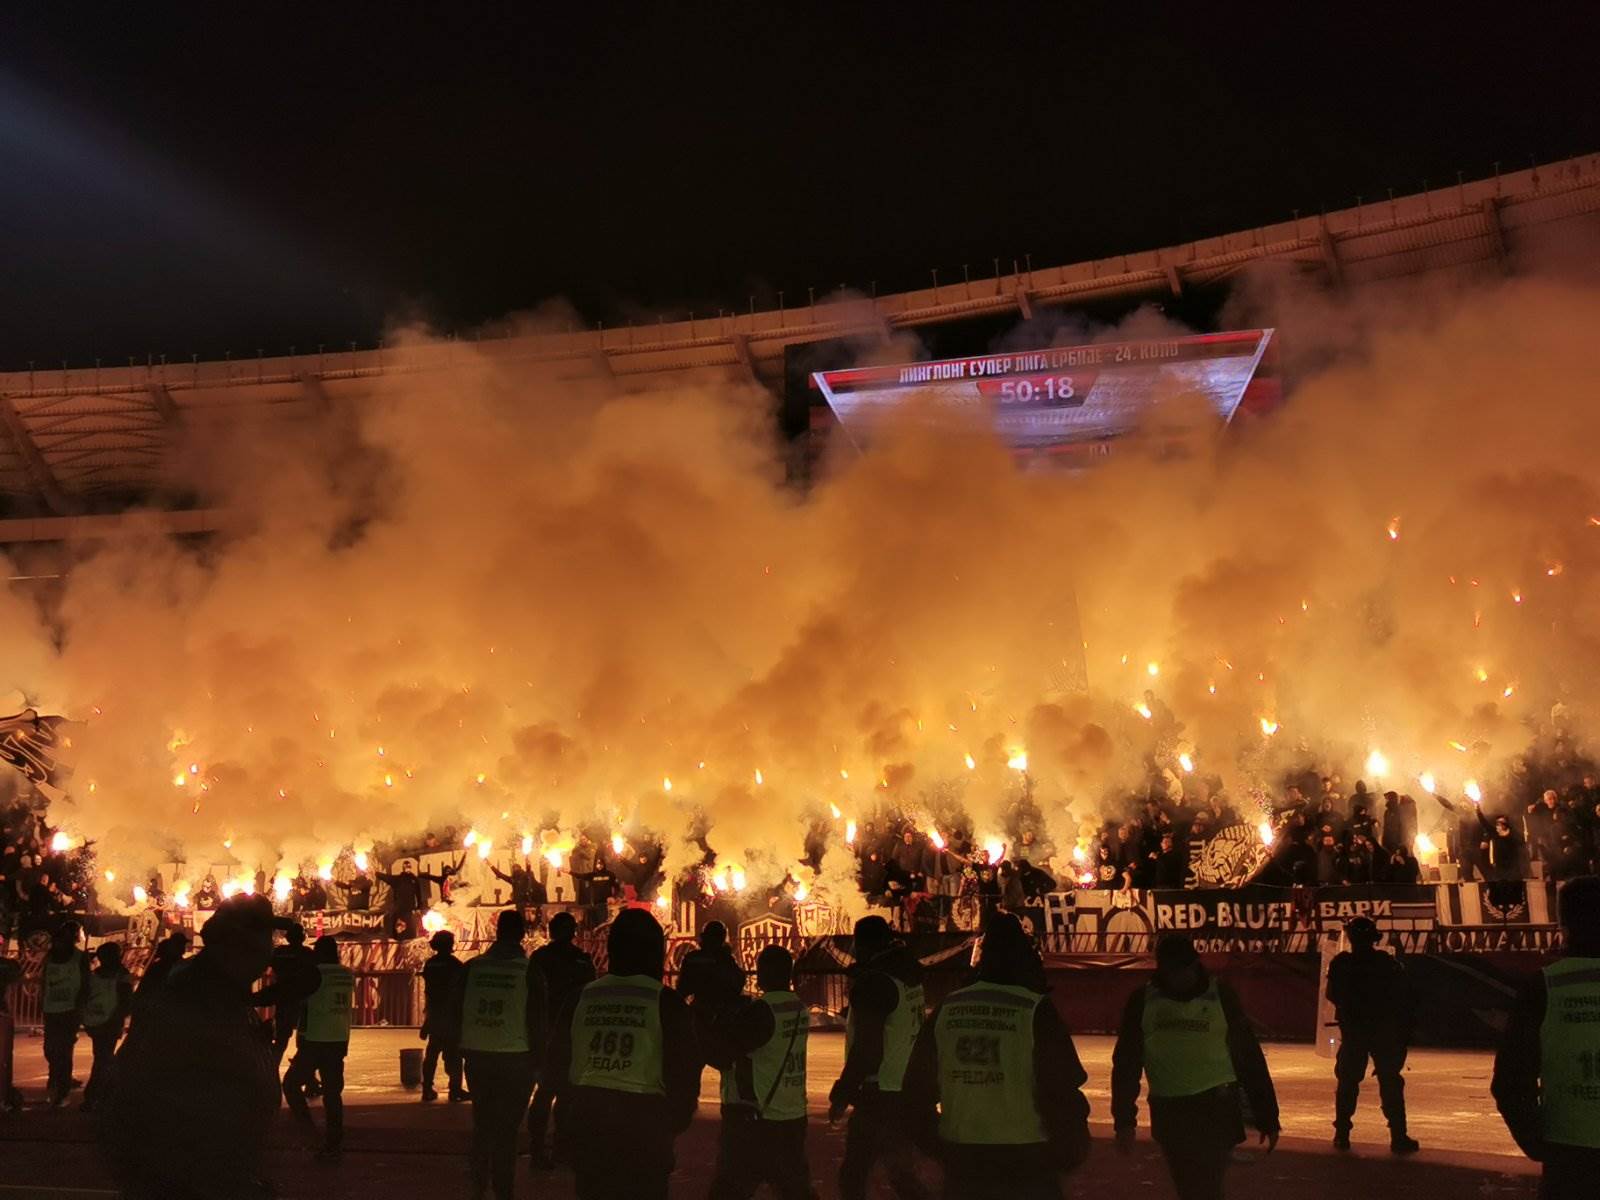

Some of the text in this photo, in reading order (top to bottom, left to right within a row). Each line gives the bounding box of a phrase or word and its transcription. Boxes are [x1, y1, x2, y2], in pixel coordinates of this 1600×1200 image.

[969, 357, 1012, 377] СУПЕР
[1015, 353, 1049, 372] ЛИГА
[1051, 348, 1103, 369] СРБИЈЕ
[1115, 345, 1138, 363] 24.
[1140, 341, 1179, 360] КОЛО
[1000, 376, 1075, 404] 50:18
[589, 1030, 635, 1058] 469
